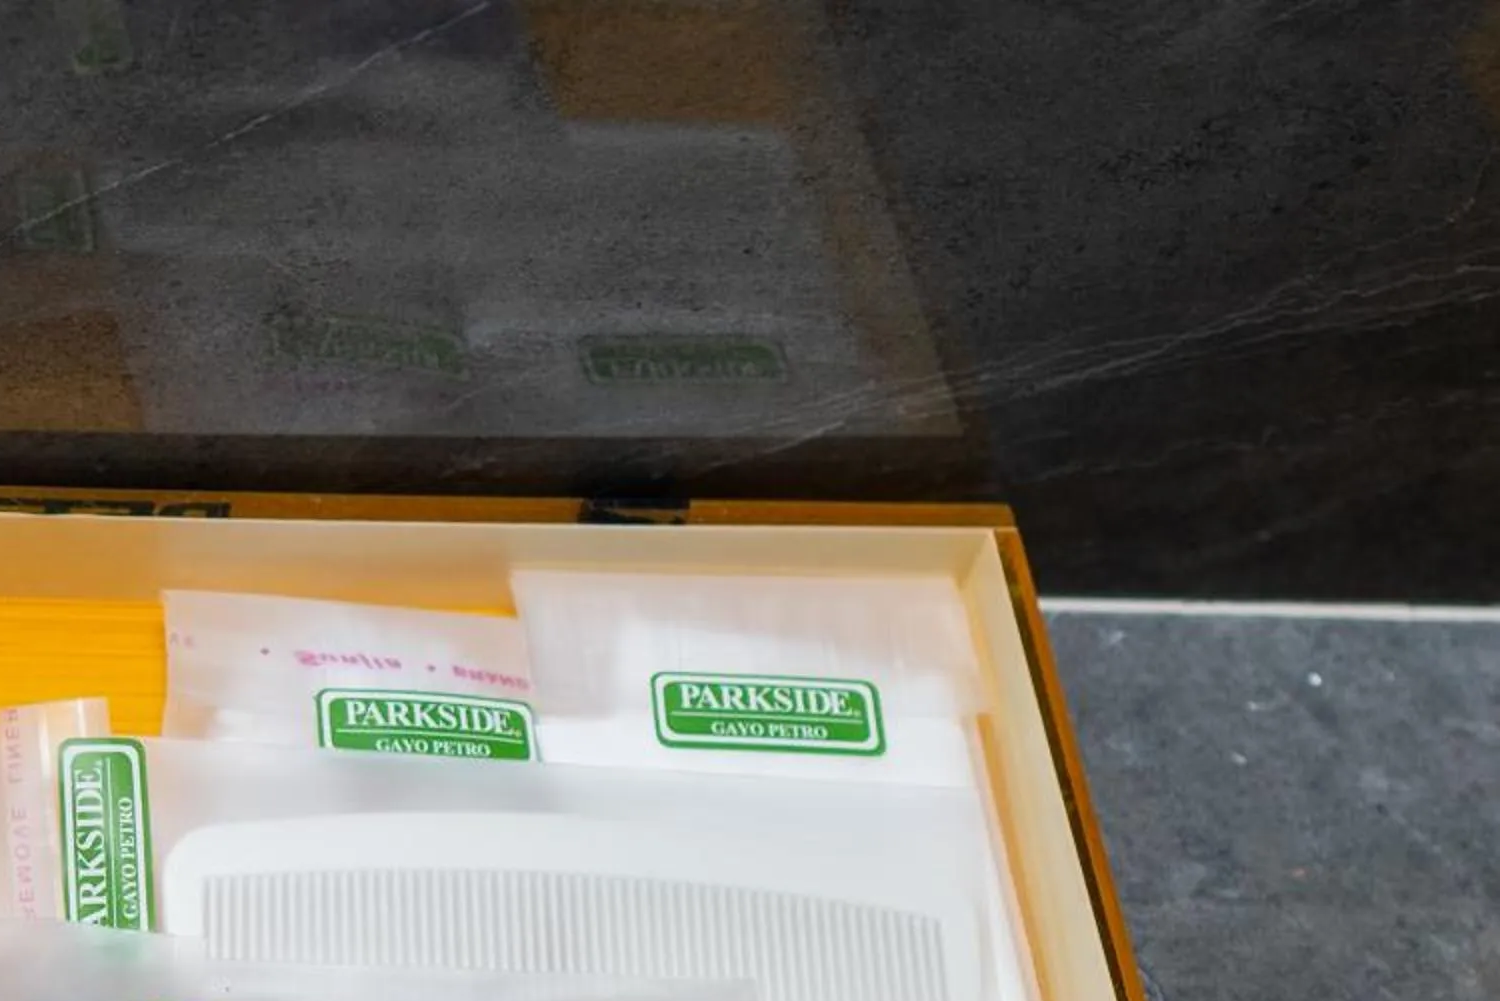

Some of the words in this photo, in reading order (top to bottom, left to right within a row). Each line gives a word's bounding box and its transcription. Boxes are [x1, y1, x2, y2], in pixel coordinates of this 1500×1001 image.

[345, 700, 515, 735] PARKSIDE
[680, 683, 853, 717] PARKSIDE
[711, 721, 764, 737] GAYO
[769, 724, 828, 739] PETRO
[376, 738, 428, 754] GAYO
[432, 741, 491, 758] PETRO
[118, 797, 137, 861] PETRO
[74, 769, 108, 929] ARKSIDE
[120, 864, 140, 919] GAYO
